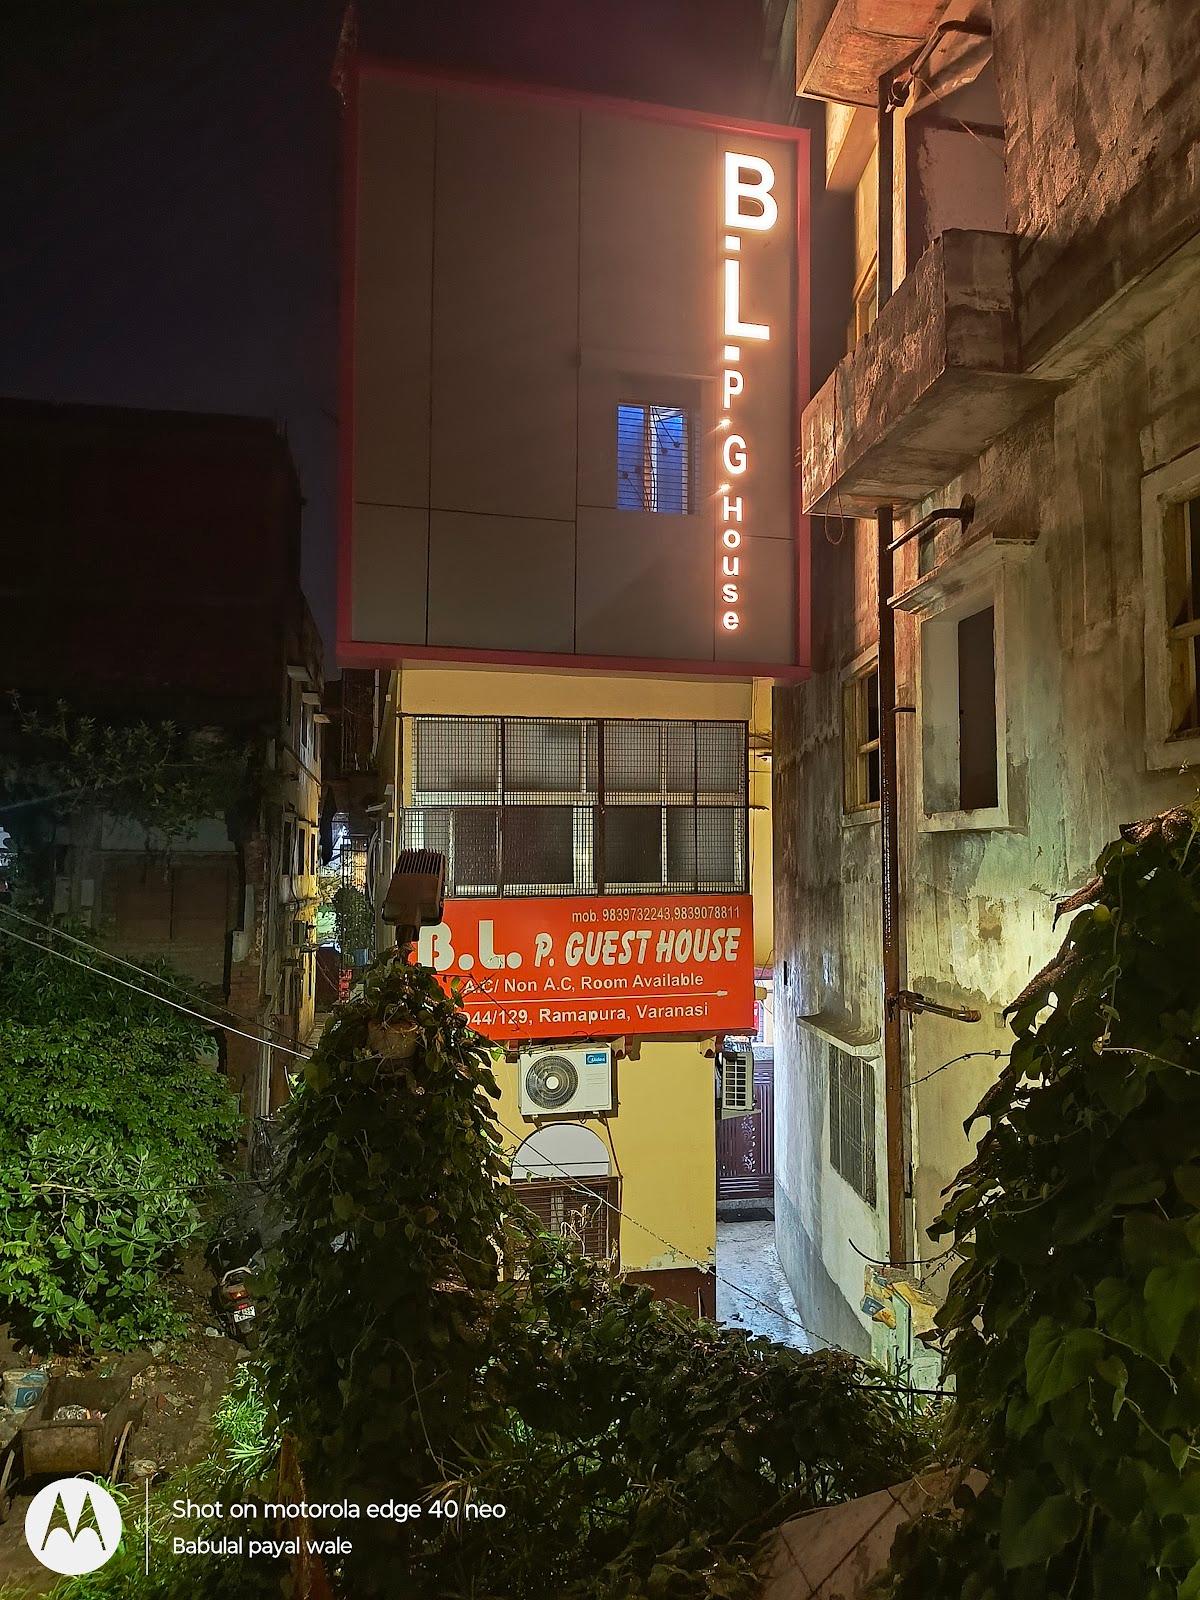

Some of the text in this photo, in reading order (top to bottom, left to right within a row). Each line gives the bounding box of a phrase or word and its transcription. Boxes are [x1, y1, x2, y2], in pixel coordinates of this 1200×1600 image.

[722, 496, 743, 631] House
[572, 910, 600, 923] mob.
[417, 919, 741, 972] B.L. P. GUEST HOUSE
[504, 978, 537, 993] Non
[581, 976, 628, 990] Room
[632, 973, 704, 989] Available
[539, 1007, 631, 1025] Ramapura,
[636, 1002, 708, 1018] Varanasi
